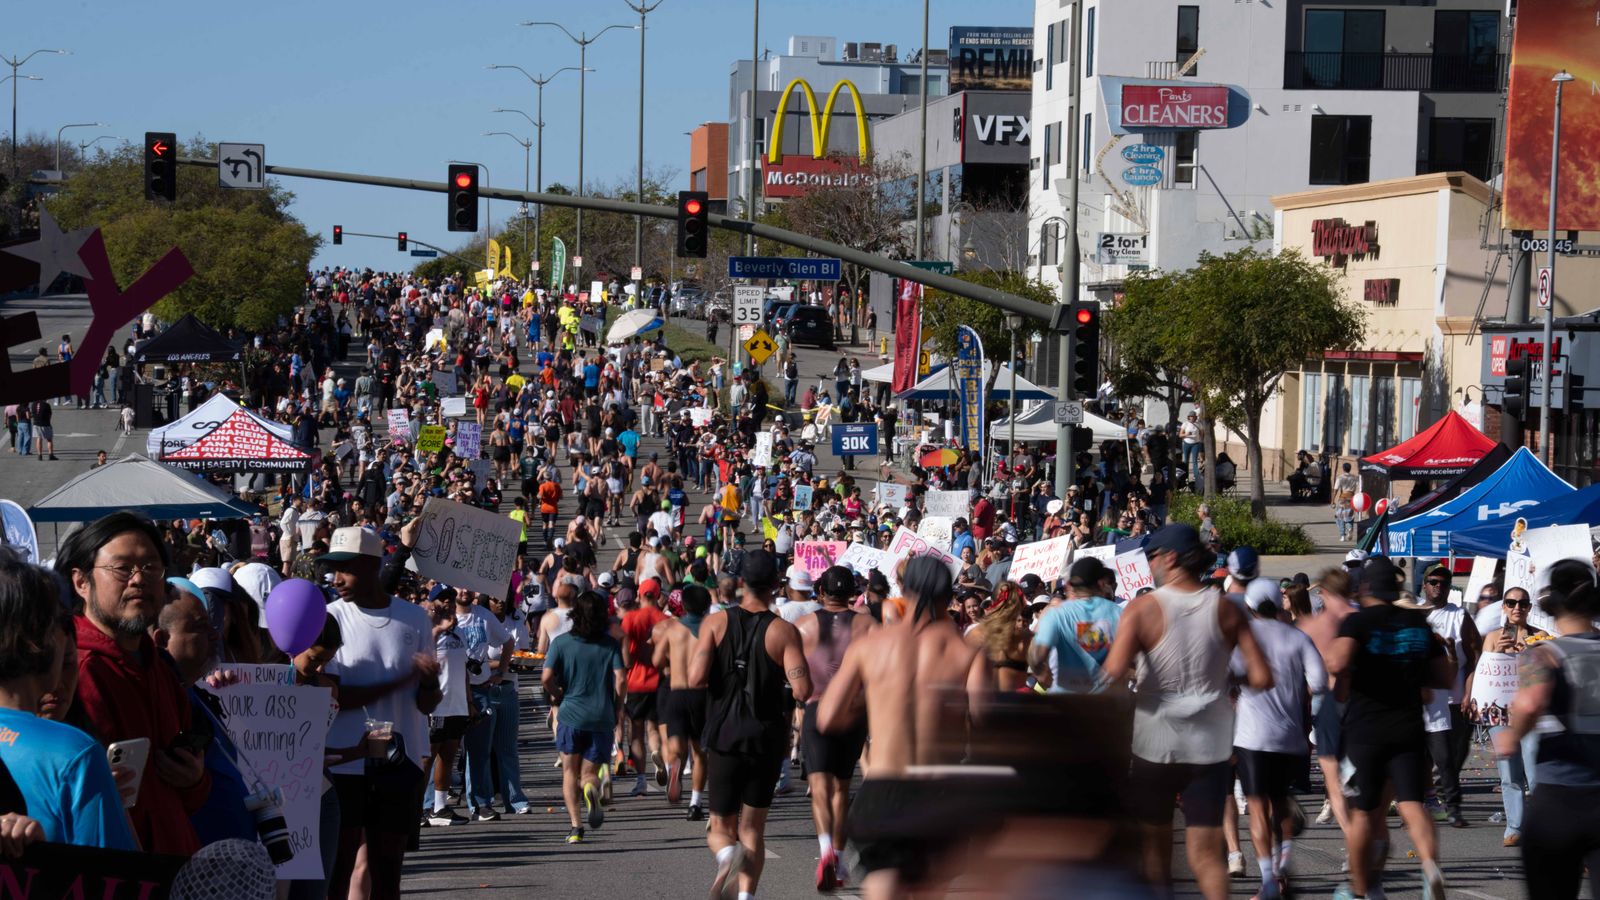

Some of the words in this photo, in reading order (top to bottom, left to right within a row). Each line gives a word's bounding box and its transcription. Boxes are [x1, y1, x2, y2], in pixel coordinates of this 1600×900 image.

[1124, 104, 1226, 125] CLEANERS
[1125, 151, 1161, 161] Cleaning
[1102, 234, 1115, 248] 2
[1118, 236, 1139, 248] for
[1141, 235, 1147, 248] 1
[1521, 239, 1572, 252] 00345
[1108, 249, 1121, 257] Dry
[735, 260, 783, 276] Beverly
[788, 262, 817, 275] Glen
[821, 262, 834, 275] Bl
[737, 289, 761, 297] SPEED
[739, 297, 758, 305] LIMIT
[737, 307, 761, 321] 35
[167, 353, 180, 361] LOS
[180, 353, 211, 361] ANGELES
[1491, 357, 1506, 373] OPEN
[204, 441, 267, 452] ANAHEIM
[841, 436, 870, 450] 30K
[207, 460, 242, 468] SAFETY
[249, 460, 306, 469] COMMUNITY
[255, 666, 276, 683] RUN
